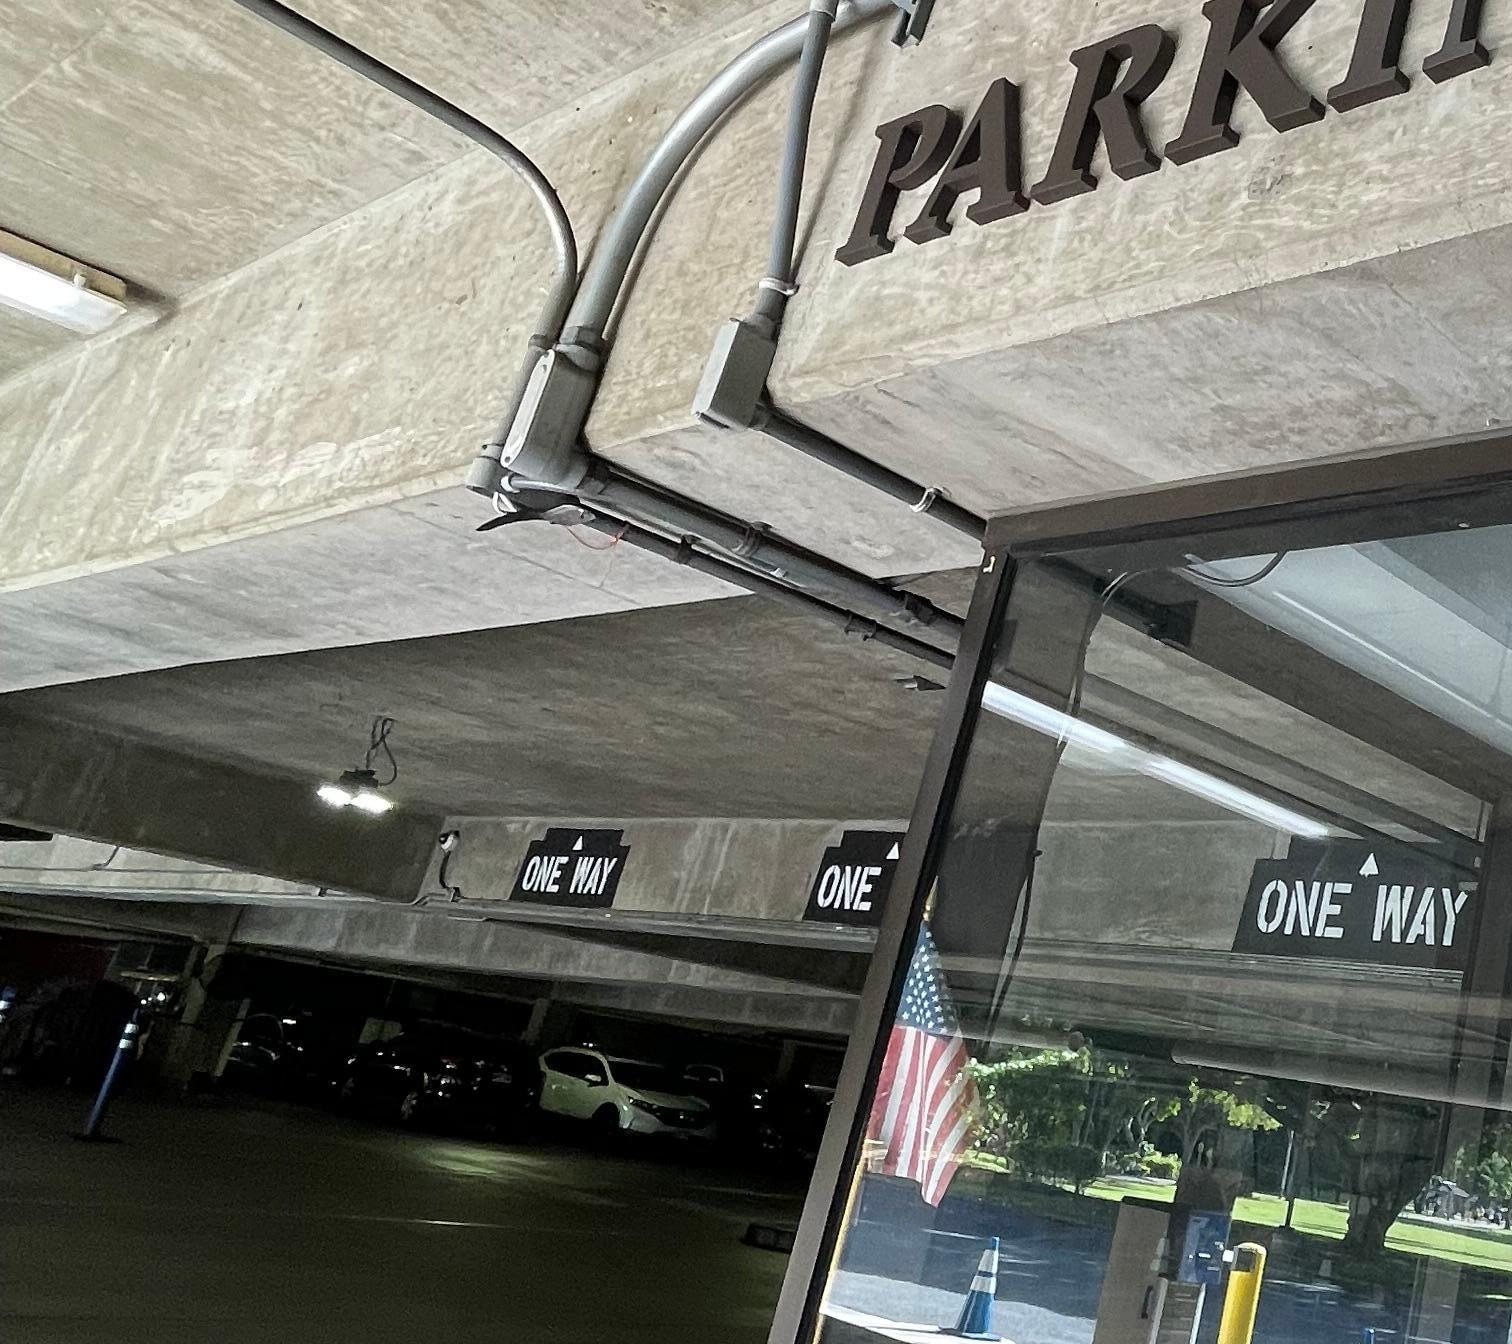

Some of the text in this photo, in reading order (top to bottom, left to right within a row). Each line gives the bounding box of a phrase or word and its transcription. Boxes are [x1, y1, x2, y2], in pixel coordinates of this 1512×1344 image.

[521, 856, 617, 896] ONE WAY
[817, 865, 882, 912] ONE
[1256, 878, 1471, 947] ONE WAY
